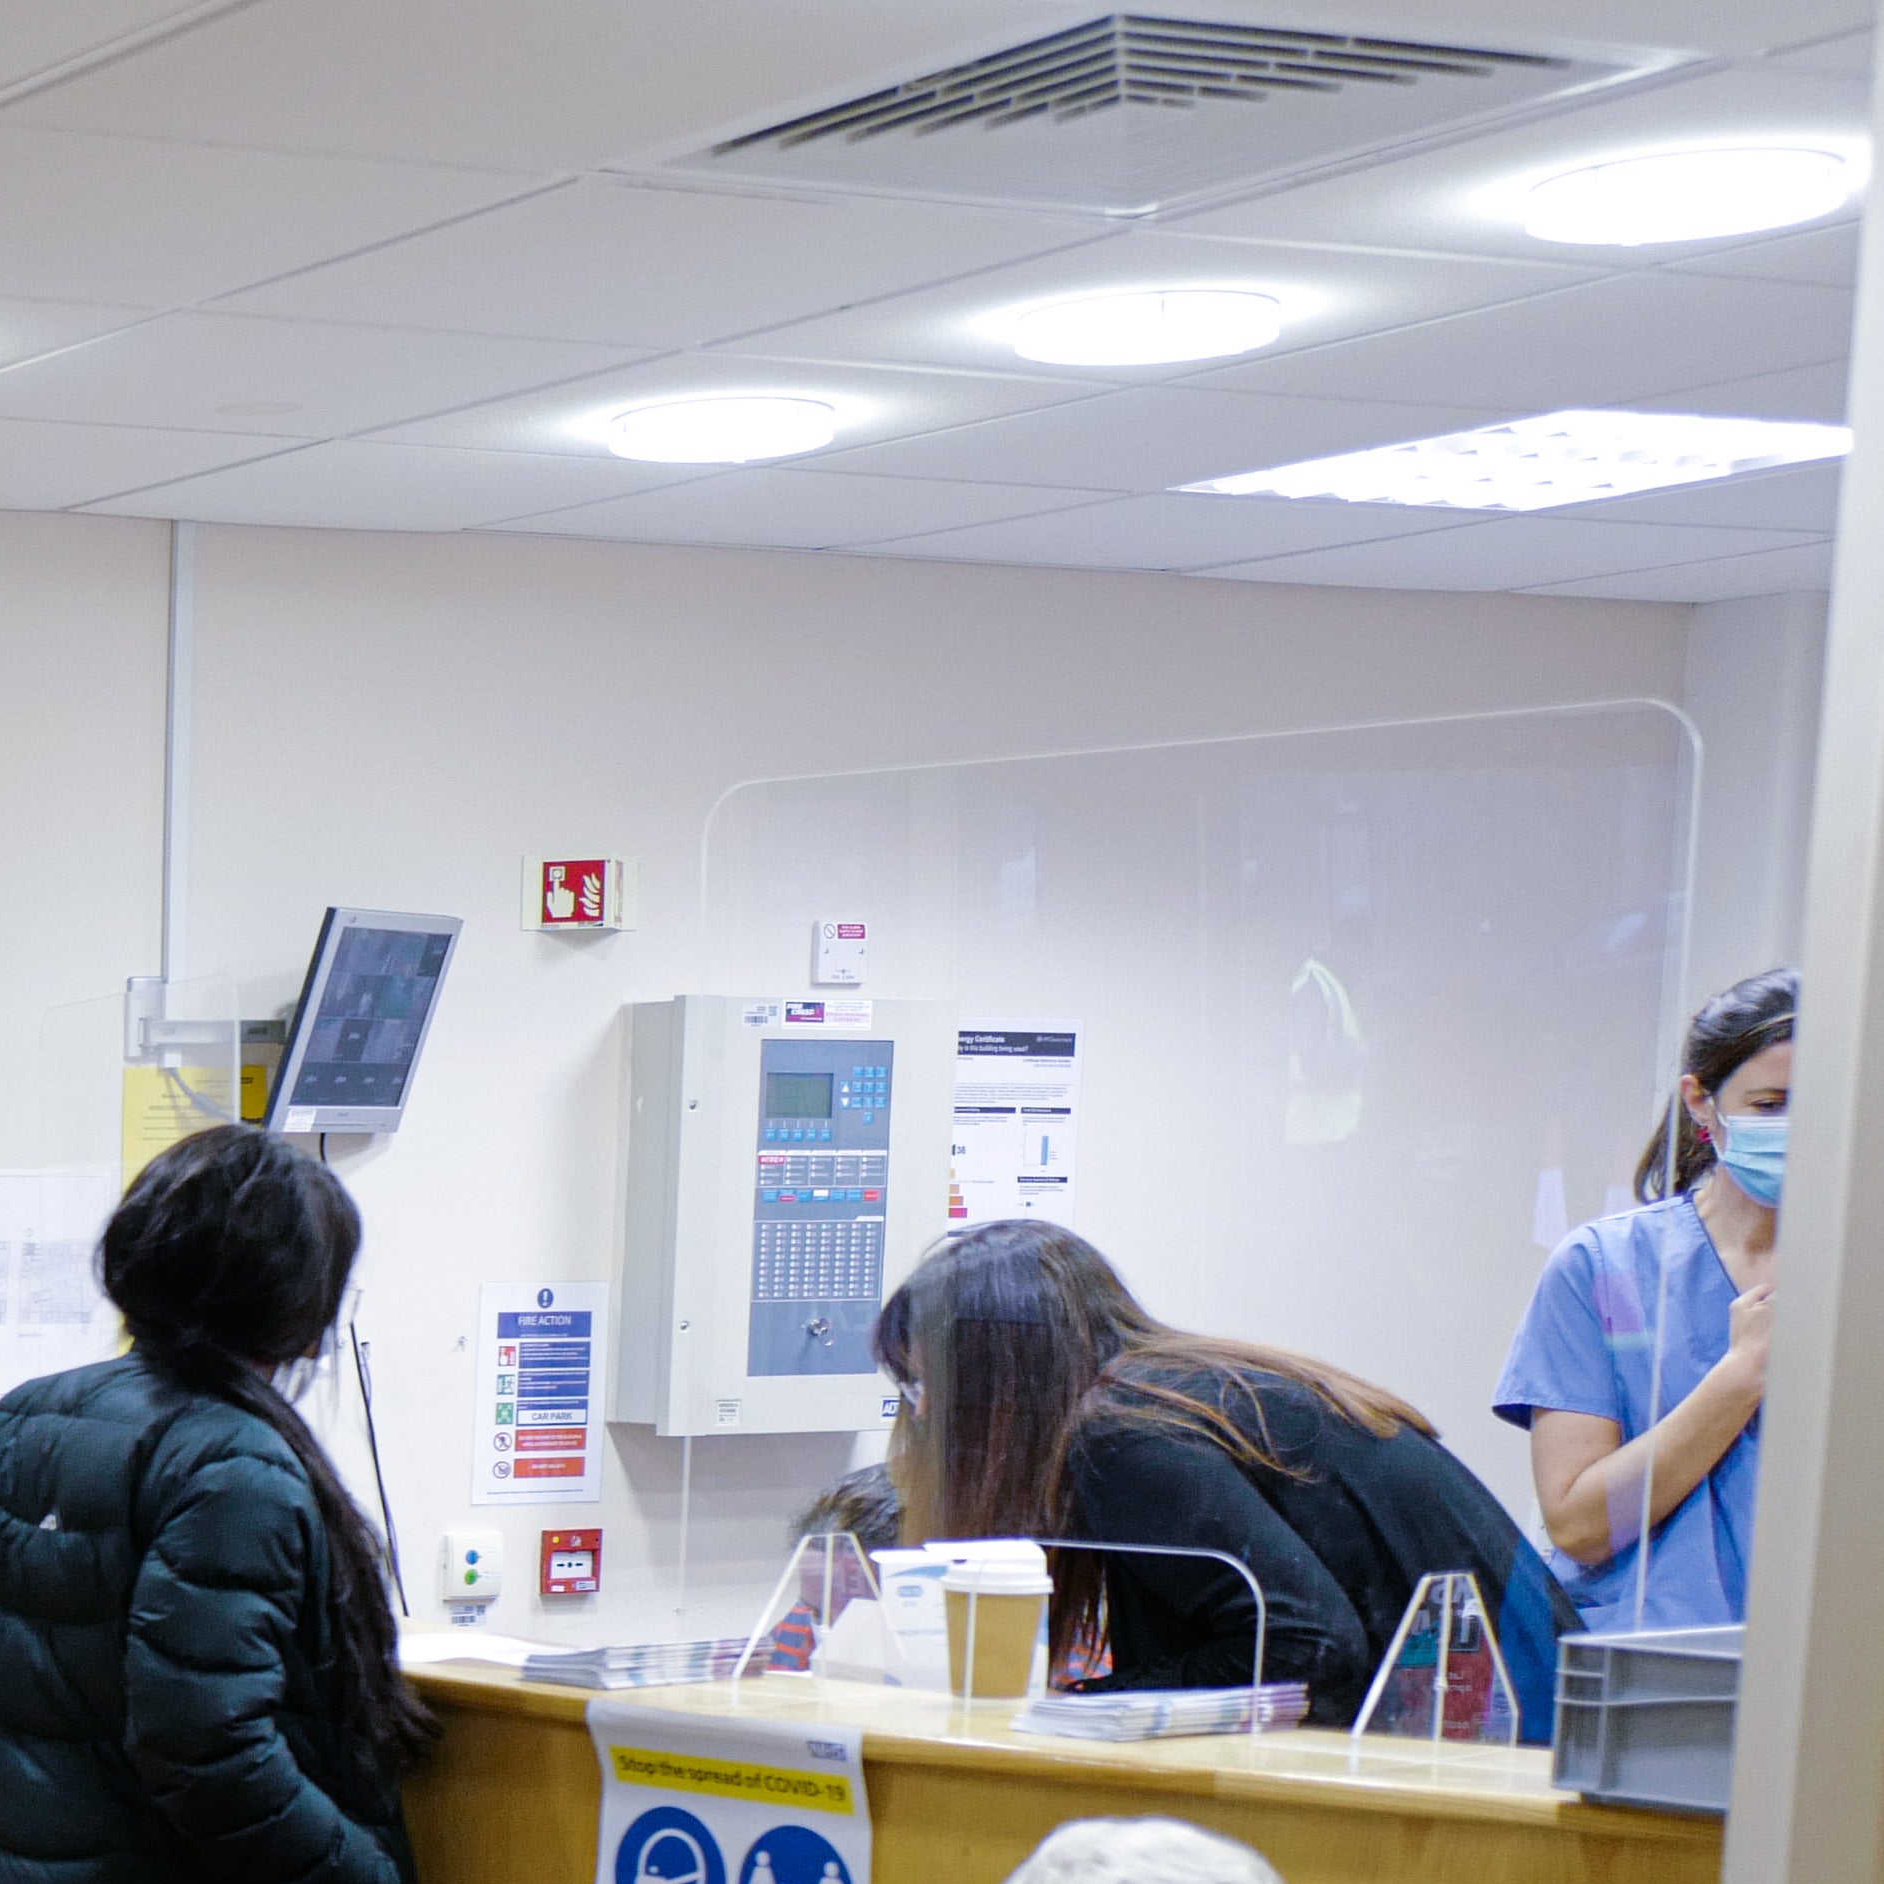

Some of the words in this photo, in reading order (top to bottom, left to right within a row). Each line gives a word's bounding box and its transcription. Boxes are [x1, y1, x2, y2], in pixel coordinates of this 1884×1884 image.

[518, 1315, 538, 1326] FIRE
[538, 1315, 572, 1326] ACTION
[532, 1412, 549, 1421] CAR
[551, 1411, 573, 1421] PARK
[619, 1755, 655, 1776] Stop
[660, 1760, 683, 1778] the
[687, 1767, 742, 1787] spread
[745, 1773, 763, 1789] of
[764, 1775, 846, 1801] COVID-19
